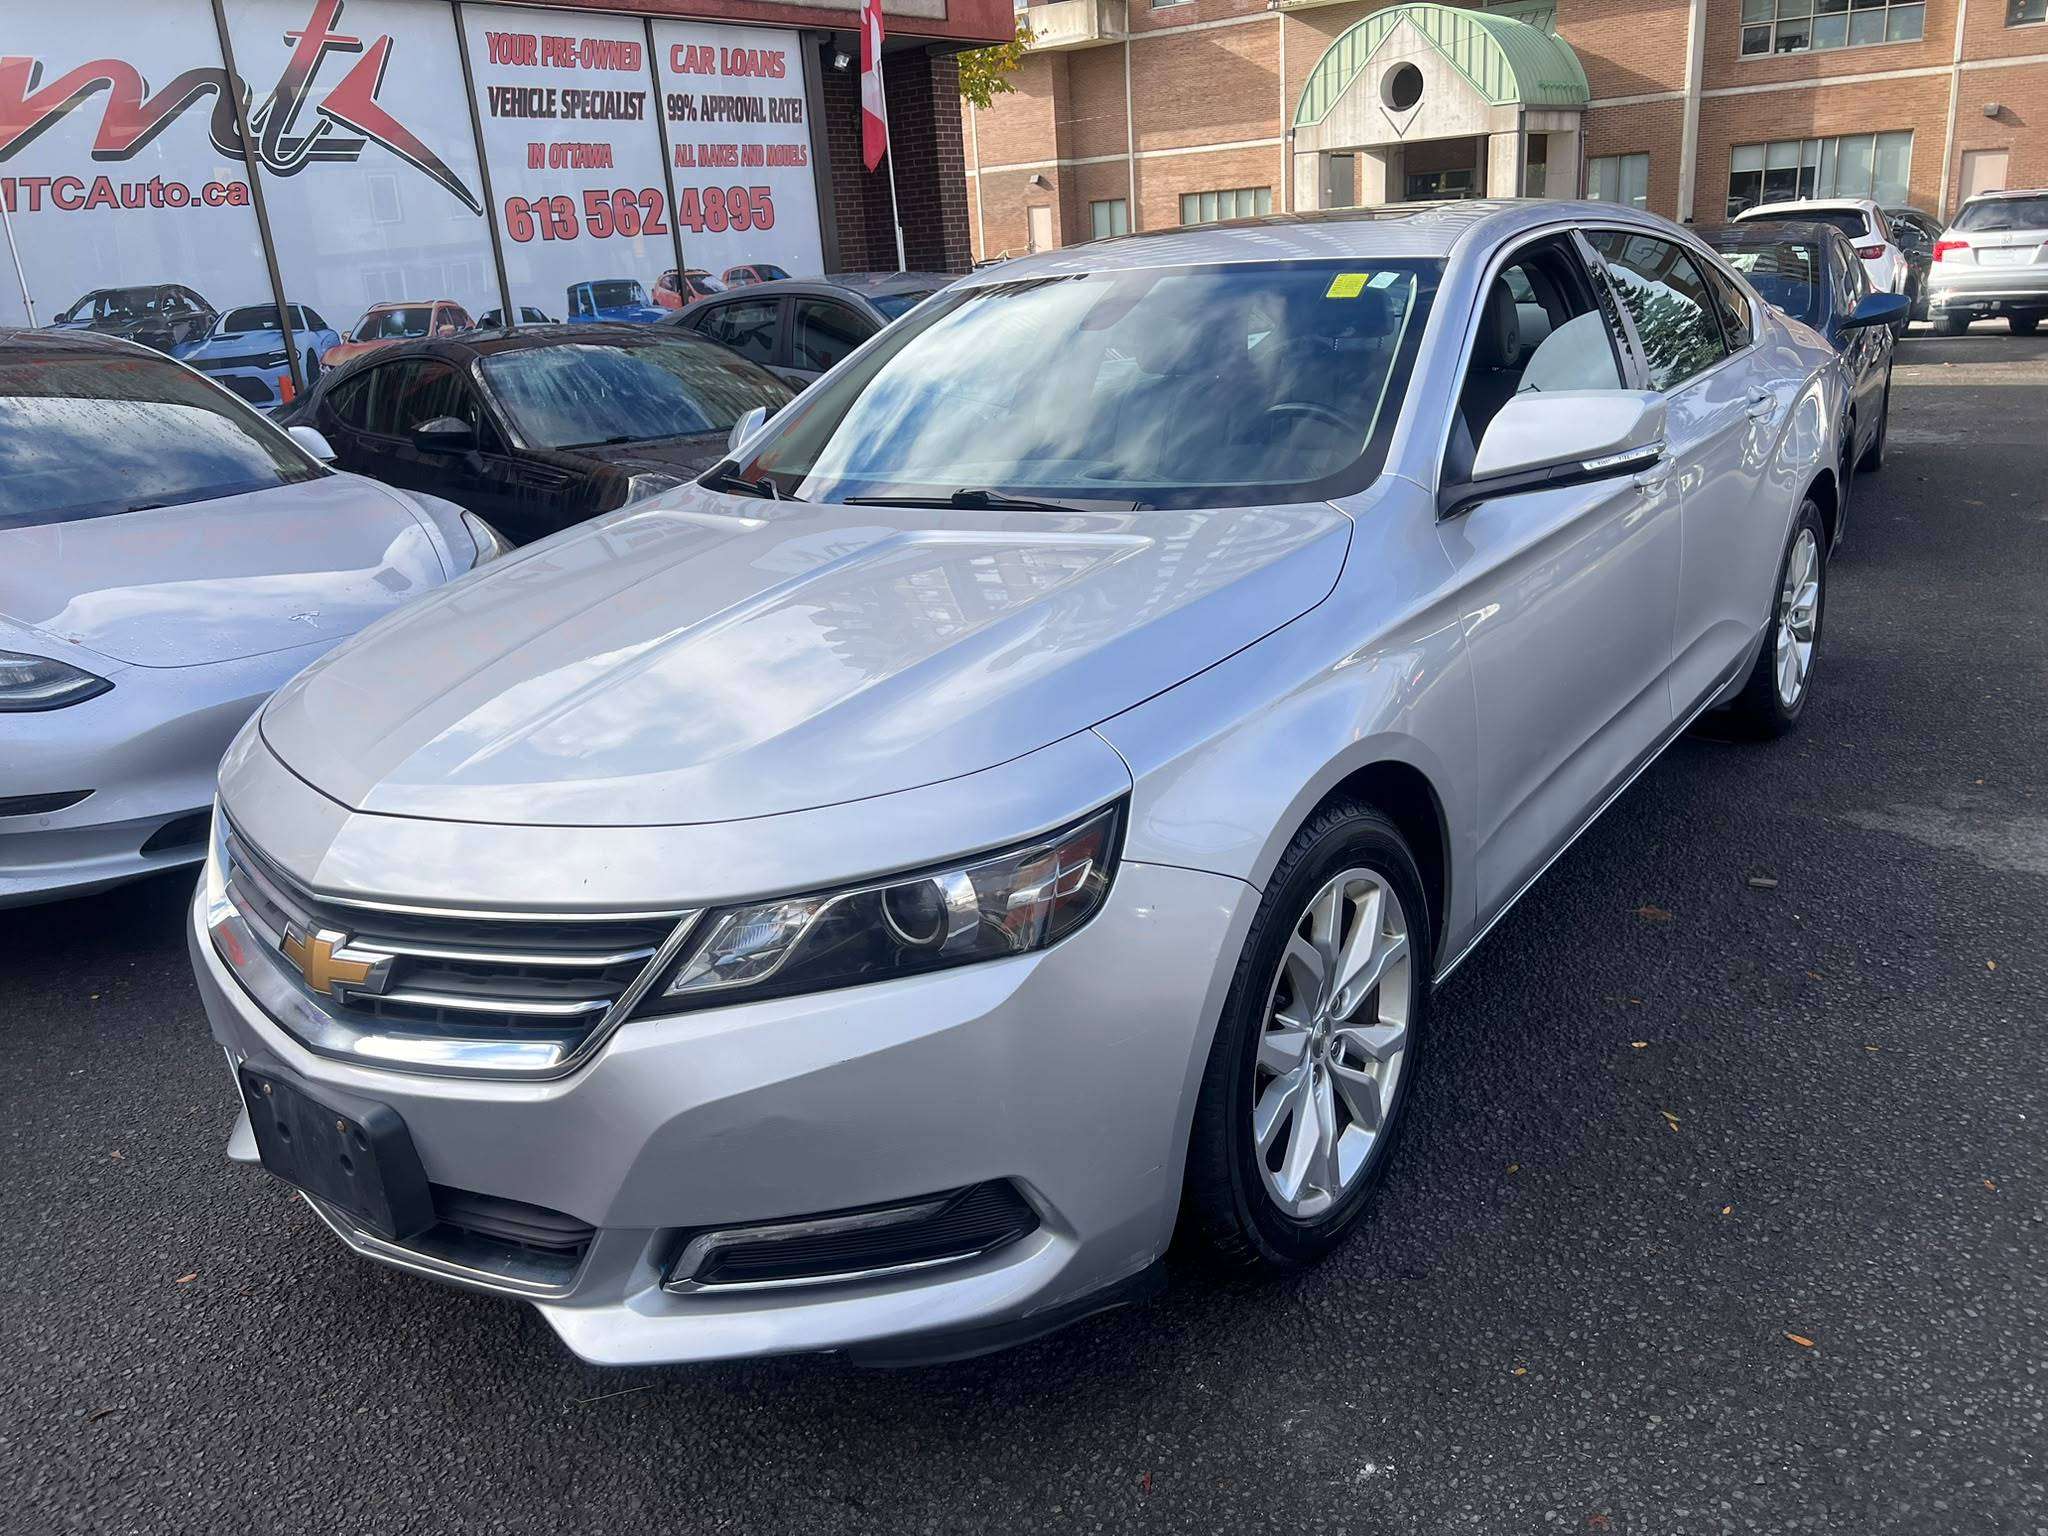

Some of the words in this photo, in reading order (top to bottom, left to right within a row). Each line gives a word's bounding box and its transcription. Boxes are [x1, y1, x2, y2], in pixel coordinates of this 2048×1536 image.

[485, 32, 537, 66] YOUR
[541, 36, 642, 72] PRE-OWNED
[670, 44, 716, 75] CAR
[720, 47, 786, 79] LOANS
[487, 86, 557, 119] VEHICLE
[560, 89, 647, 121] SPECIALIST
[667, 93, 698, 122] 99%
[700, 94, 767, 123] APPROVAL
[768, 97, 803, 124] RATE!
[527, 142, 546, 170] IN
[549, 142, 614, 169] OTTAWA
[674, 143, 697, 168] ALL
[697, 143, 739, 168] MAKES
[740, 144, 764, 167] AND
[765, 144, 808, 167] MODELS
[504, 195, 580, 243] 613
[583, 188, 668, 239] 562
[679, 185, 775, 234] 4895
